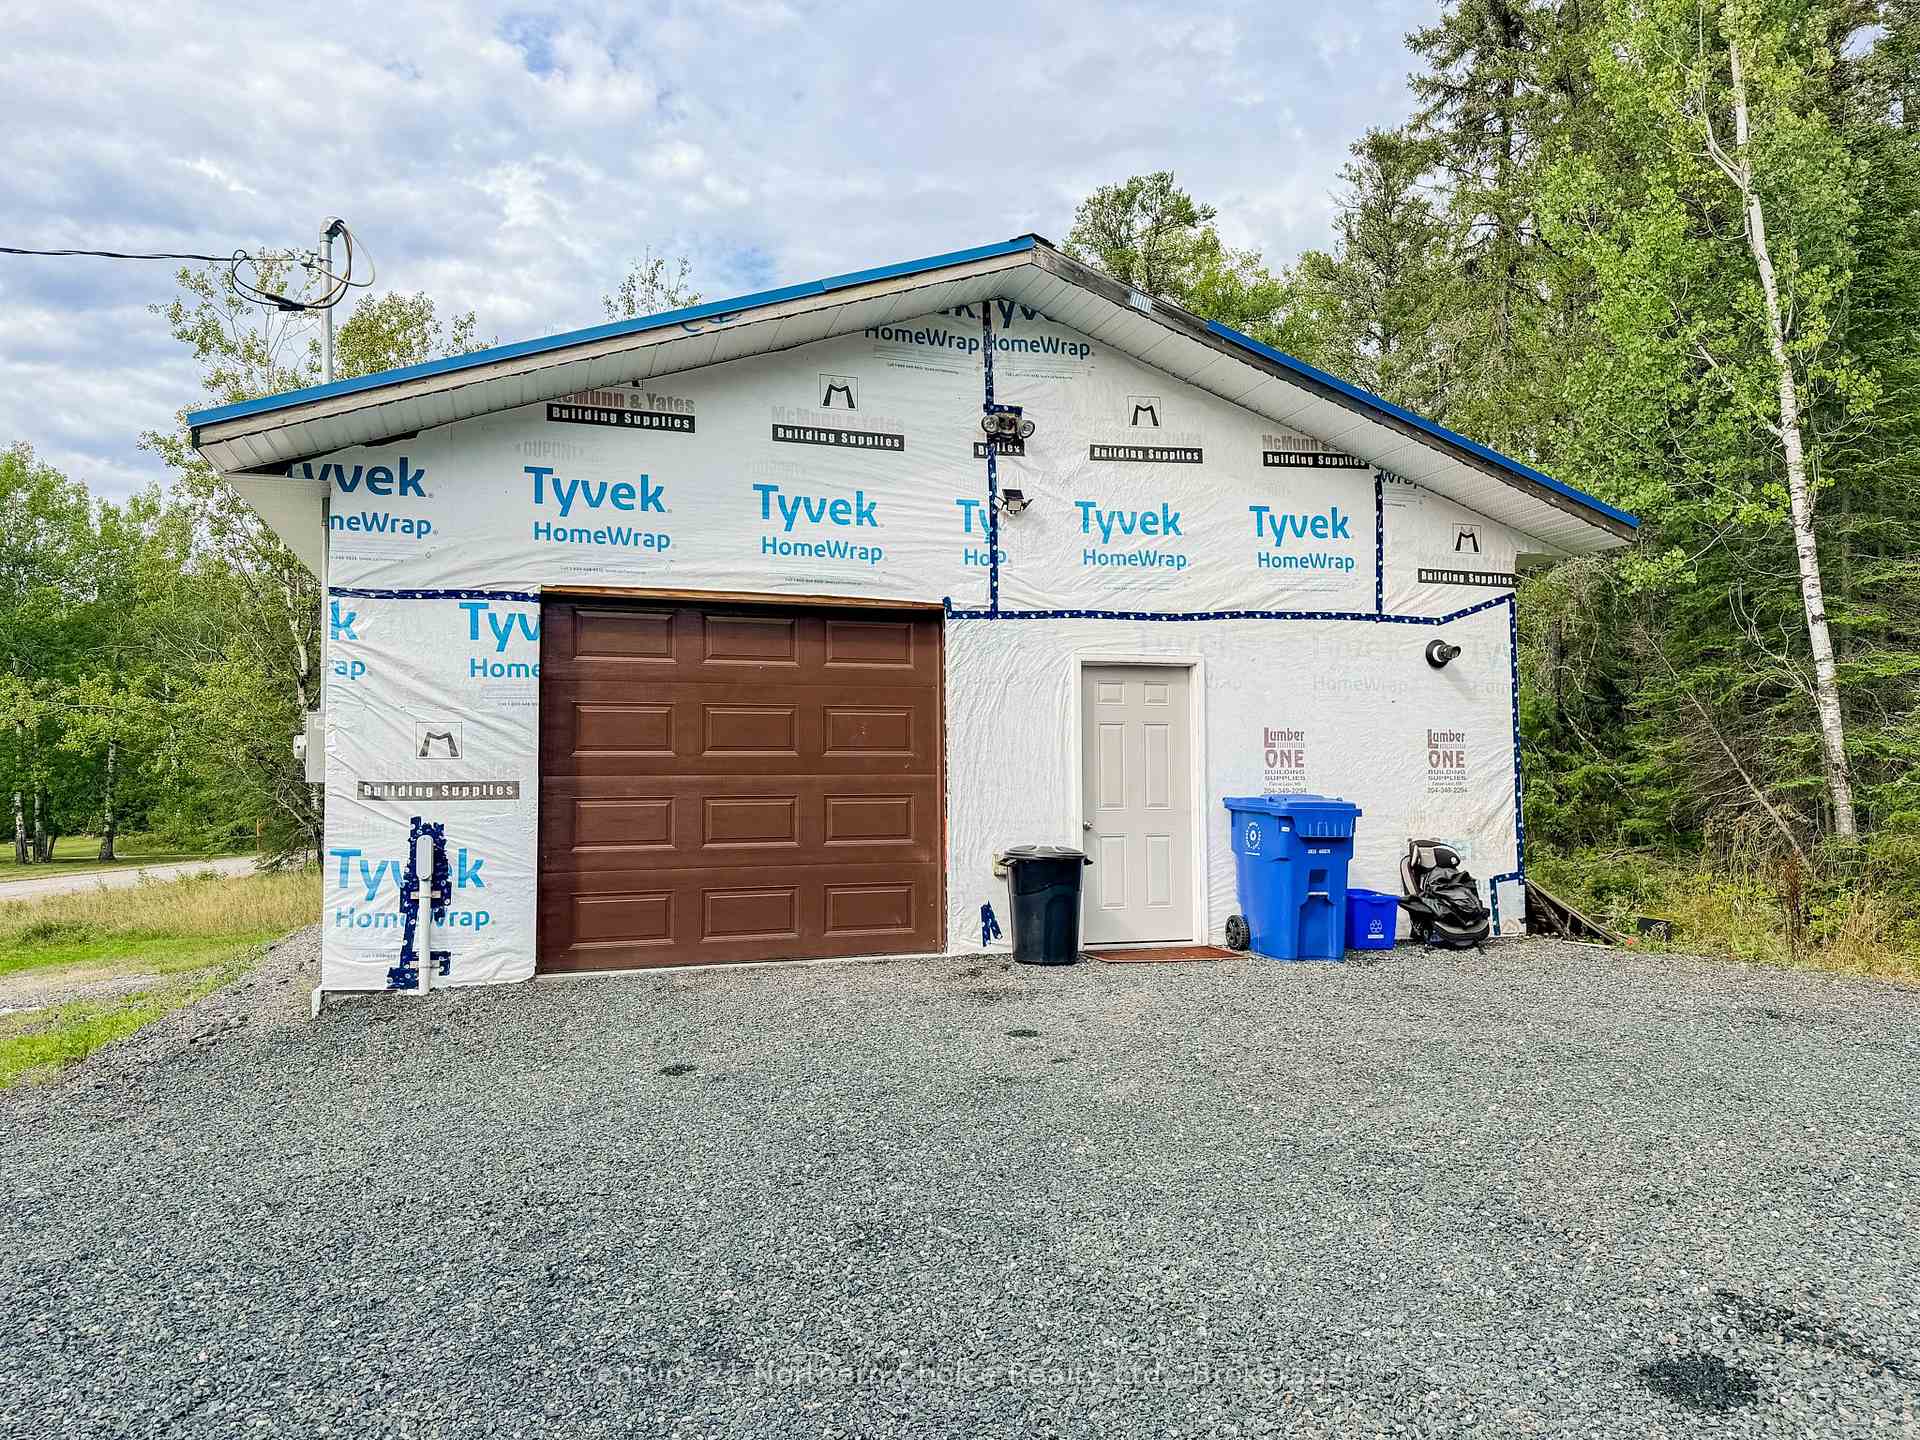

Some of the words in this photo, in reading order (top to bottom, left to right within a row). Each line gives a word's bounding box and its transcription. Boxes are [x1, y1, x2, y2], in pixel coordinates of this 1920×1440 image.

[552, 406, 617, 424] Building
[624, 412, 691, 429] Supplies
[777, 427, 836, 443] Building
[841, 432, 900, 448] Supplies
[1094, 447, 1143, 460] Building
[1148, 449, 1198, 460] Supplies
[1267, 453, 1314, 466] Building
[1318, 455, 1366, 467] Supplies
[523, 465, 666, 518] Tyvek
[752, 483, 878, 532] Tyvek
[1074, 500, 1182, 544] Tyvek
[1249, 504, 1350, 547] Tyvek
[533, 521, 671, 552] HomeWrap
[761, 536, 883, 564] HomeWrap
[1083, 550, 1187, 569] HomeWrap
[1257, 551, 1355, 573] HomeWrap
[1421, 570, 1465, 583] Building
[1469, 573, 1513, 585] Supplies
[459, 602, 540, 652] Tyv
[469, 656, 540, 679] Home
[1264, 727, 1304, 748] Lumber
[1428, 729, 1465, 749] Lumber
[1265, 749, 1305, 768] ONE
[1428, 750, 1465, 768] ONE
[363, 784, 434, 798] Building
[441, 784, 514, 798] Supplies
